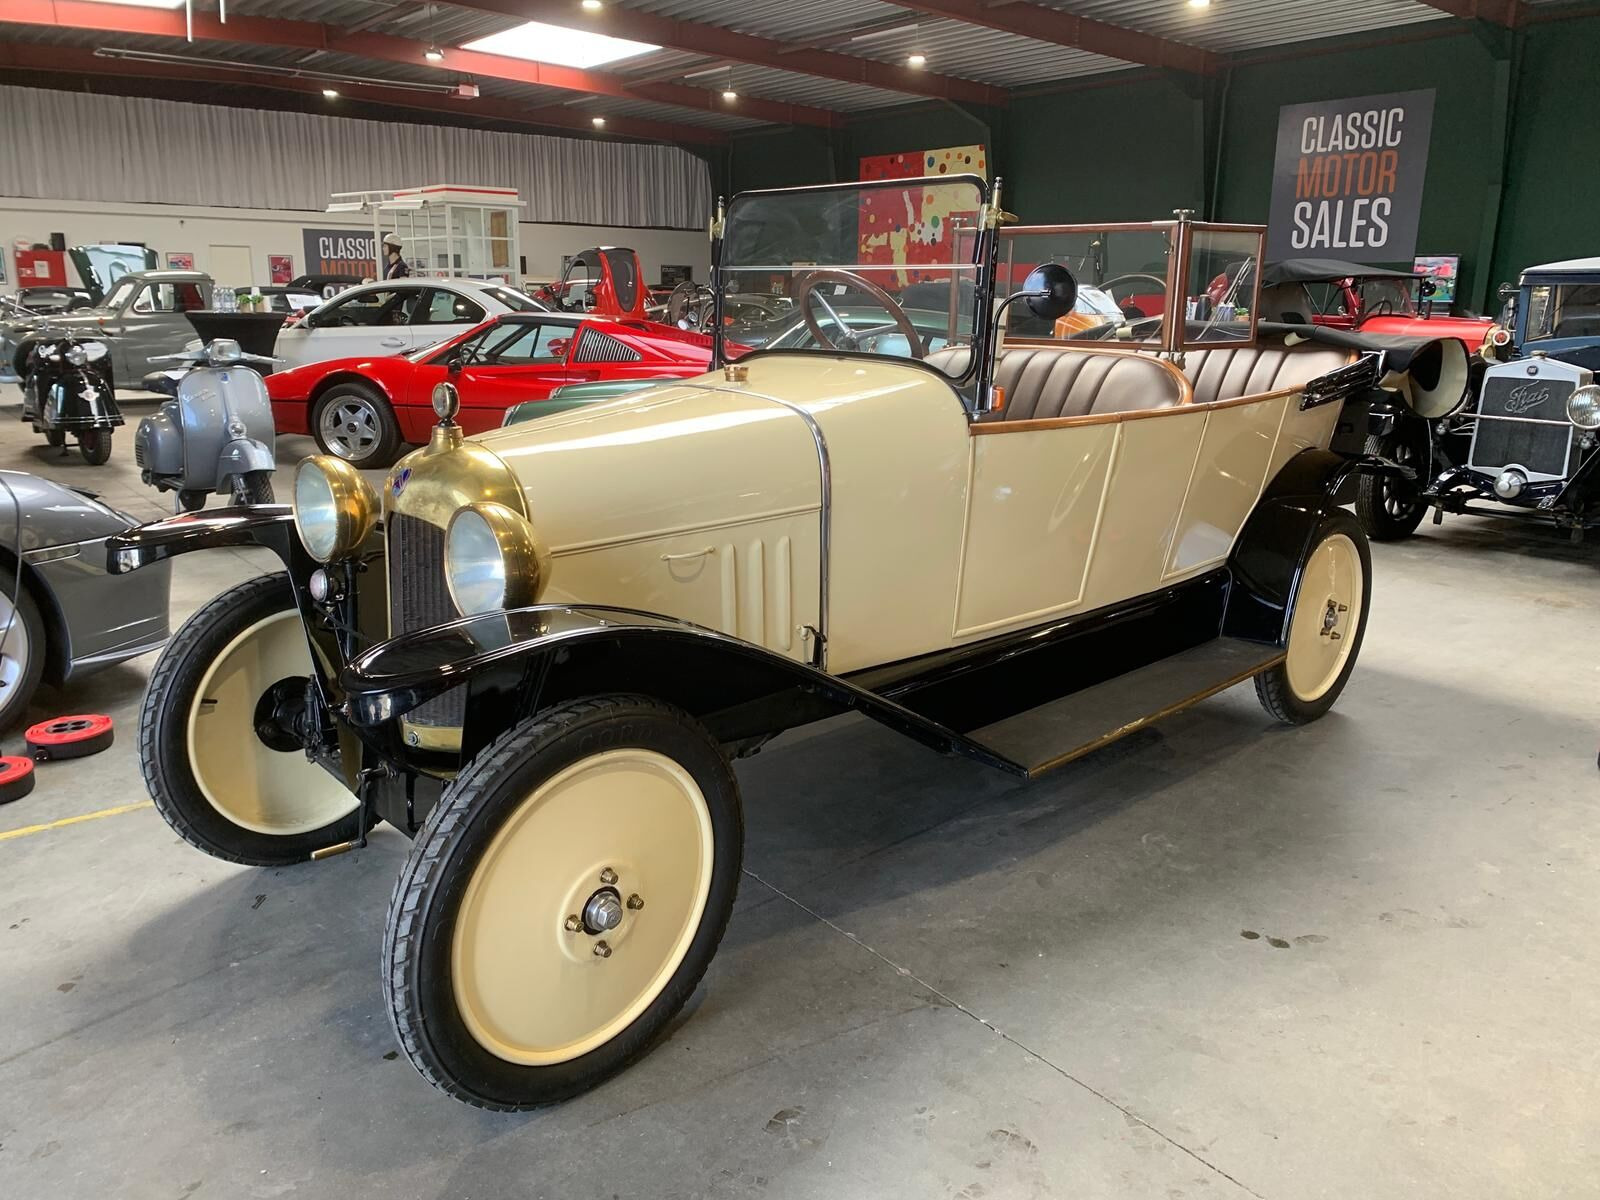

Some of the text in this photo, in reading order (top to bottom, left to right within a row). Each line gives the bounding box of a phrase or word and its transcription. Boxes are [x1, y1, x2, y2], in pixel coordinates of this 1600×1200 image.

[1301, 107, 1404, 154] CLASSIC
[1295, 149, 1399, 199] MOTOR
[1291, 197, 1392, 249] SALES
